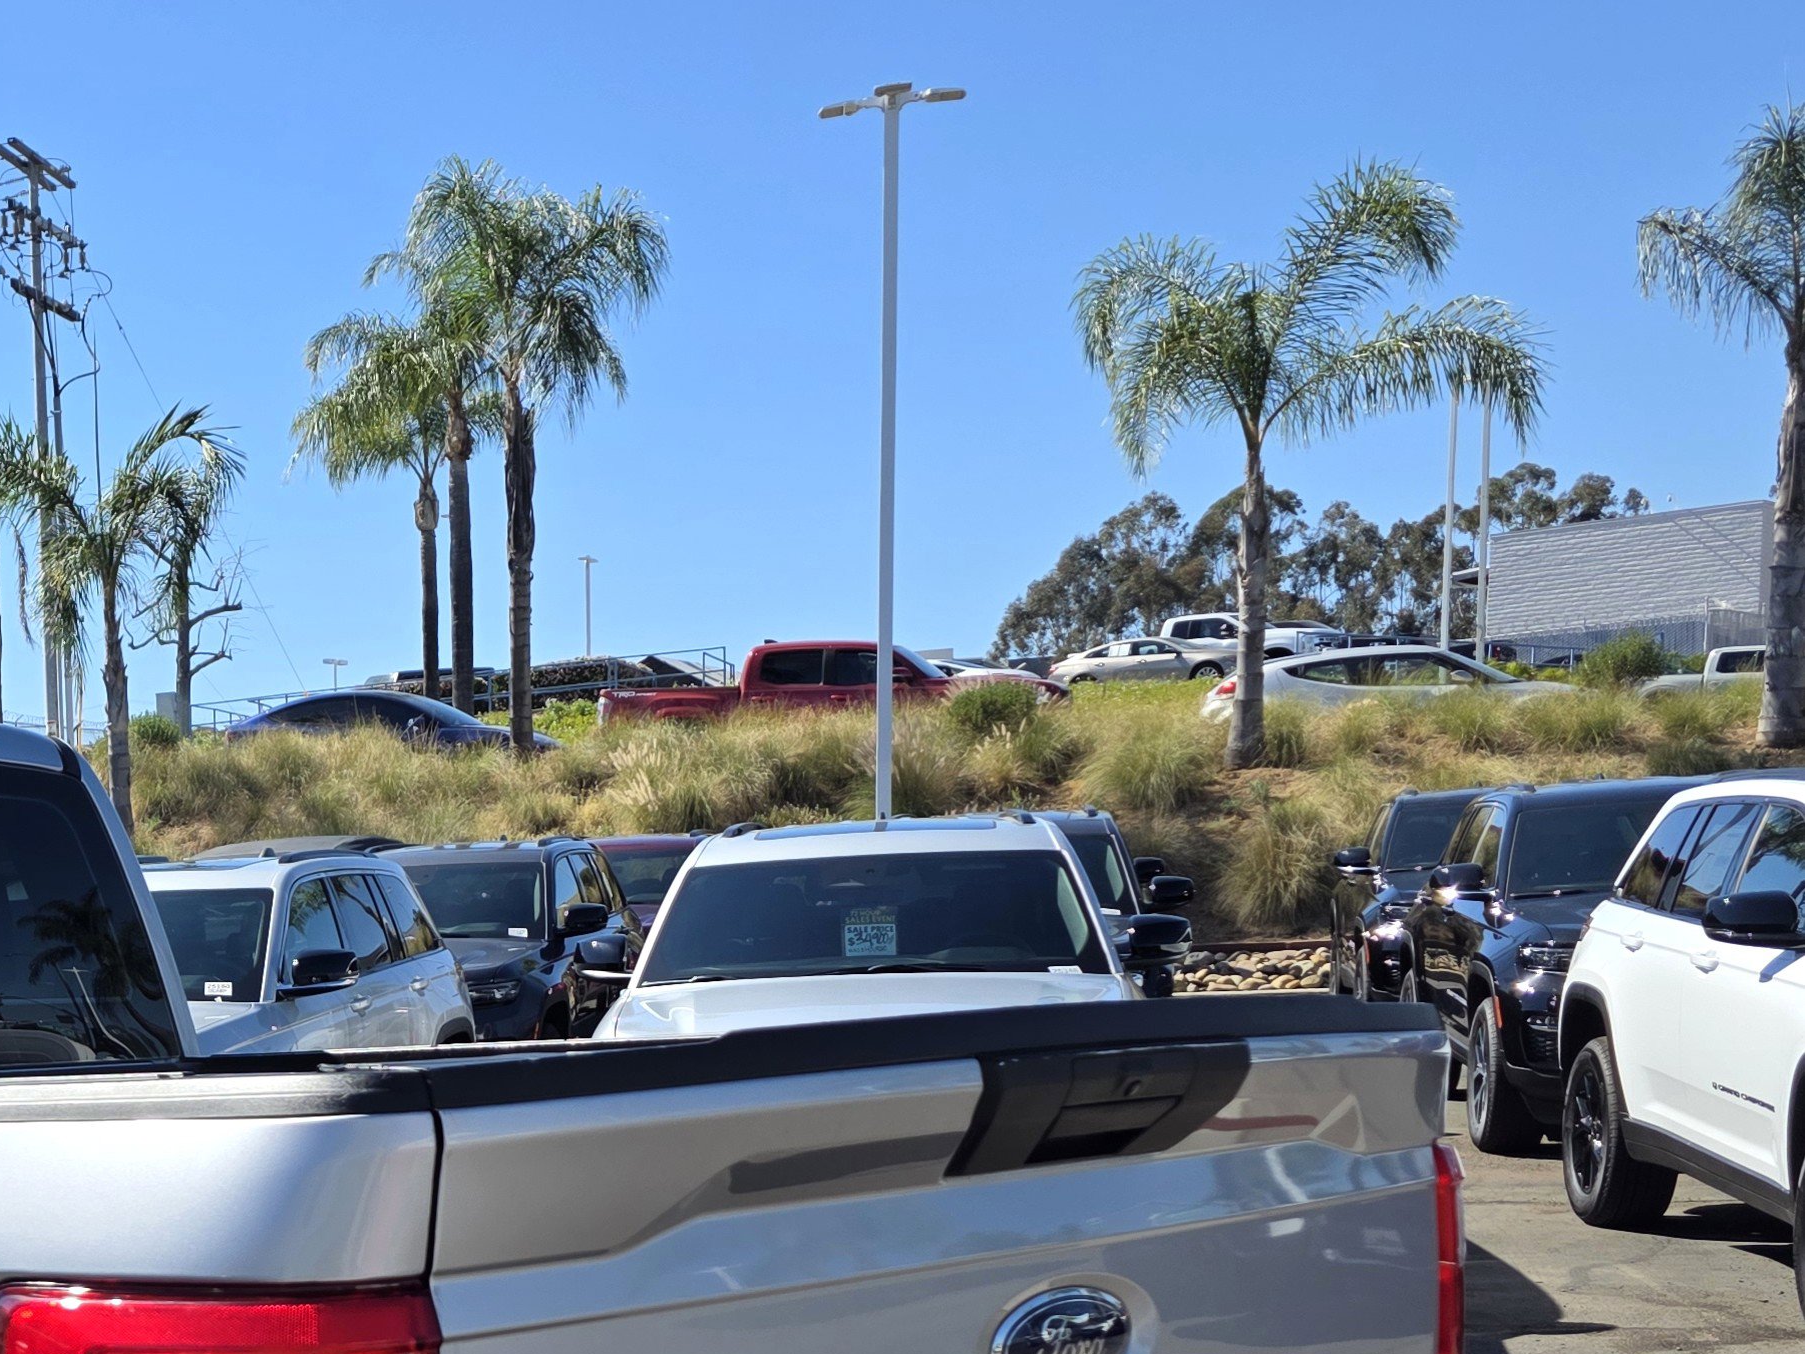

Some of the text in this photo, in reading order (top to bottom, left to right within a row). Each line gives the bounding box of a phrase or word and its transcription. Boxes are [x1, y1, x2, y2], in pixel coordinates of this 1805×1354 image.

[845, 915, 896, 924] SALES EVENT
[870, 925, 894, 933] PRICE
